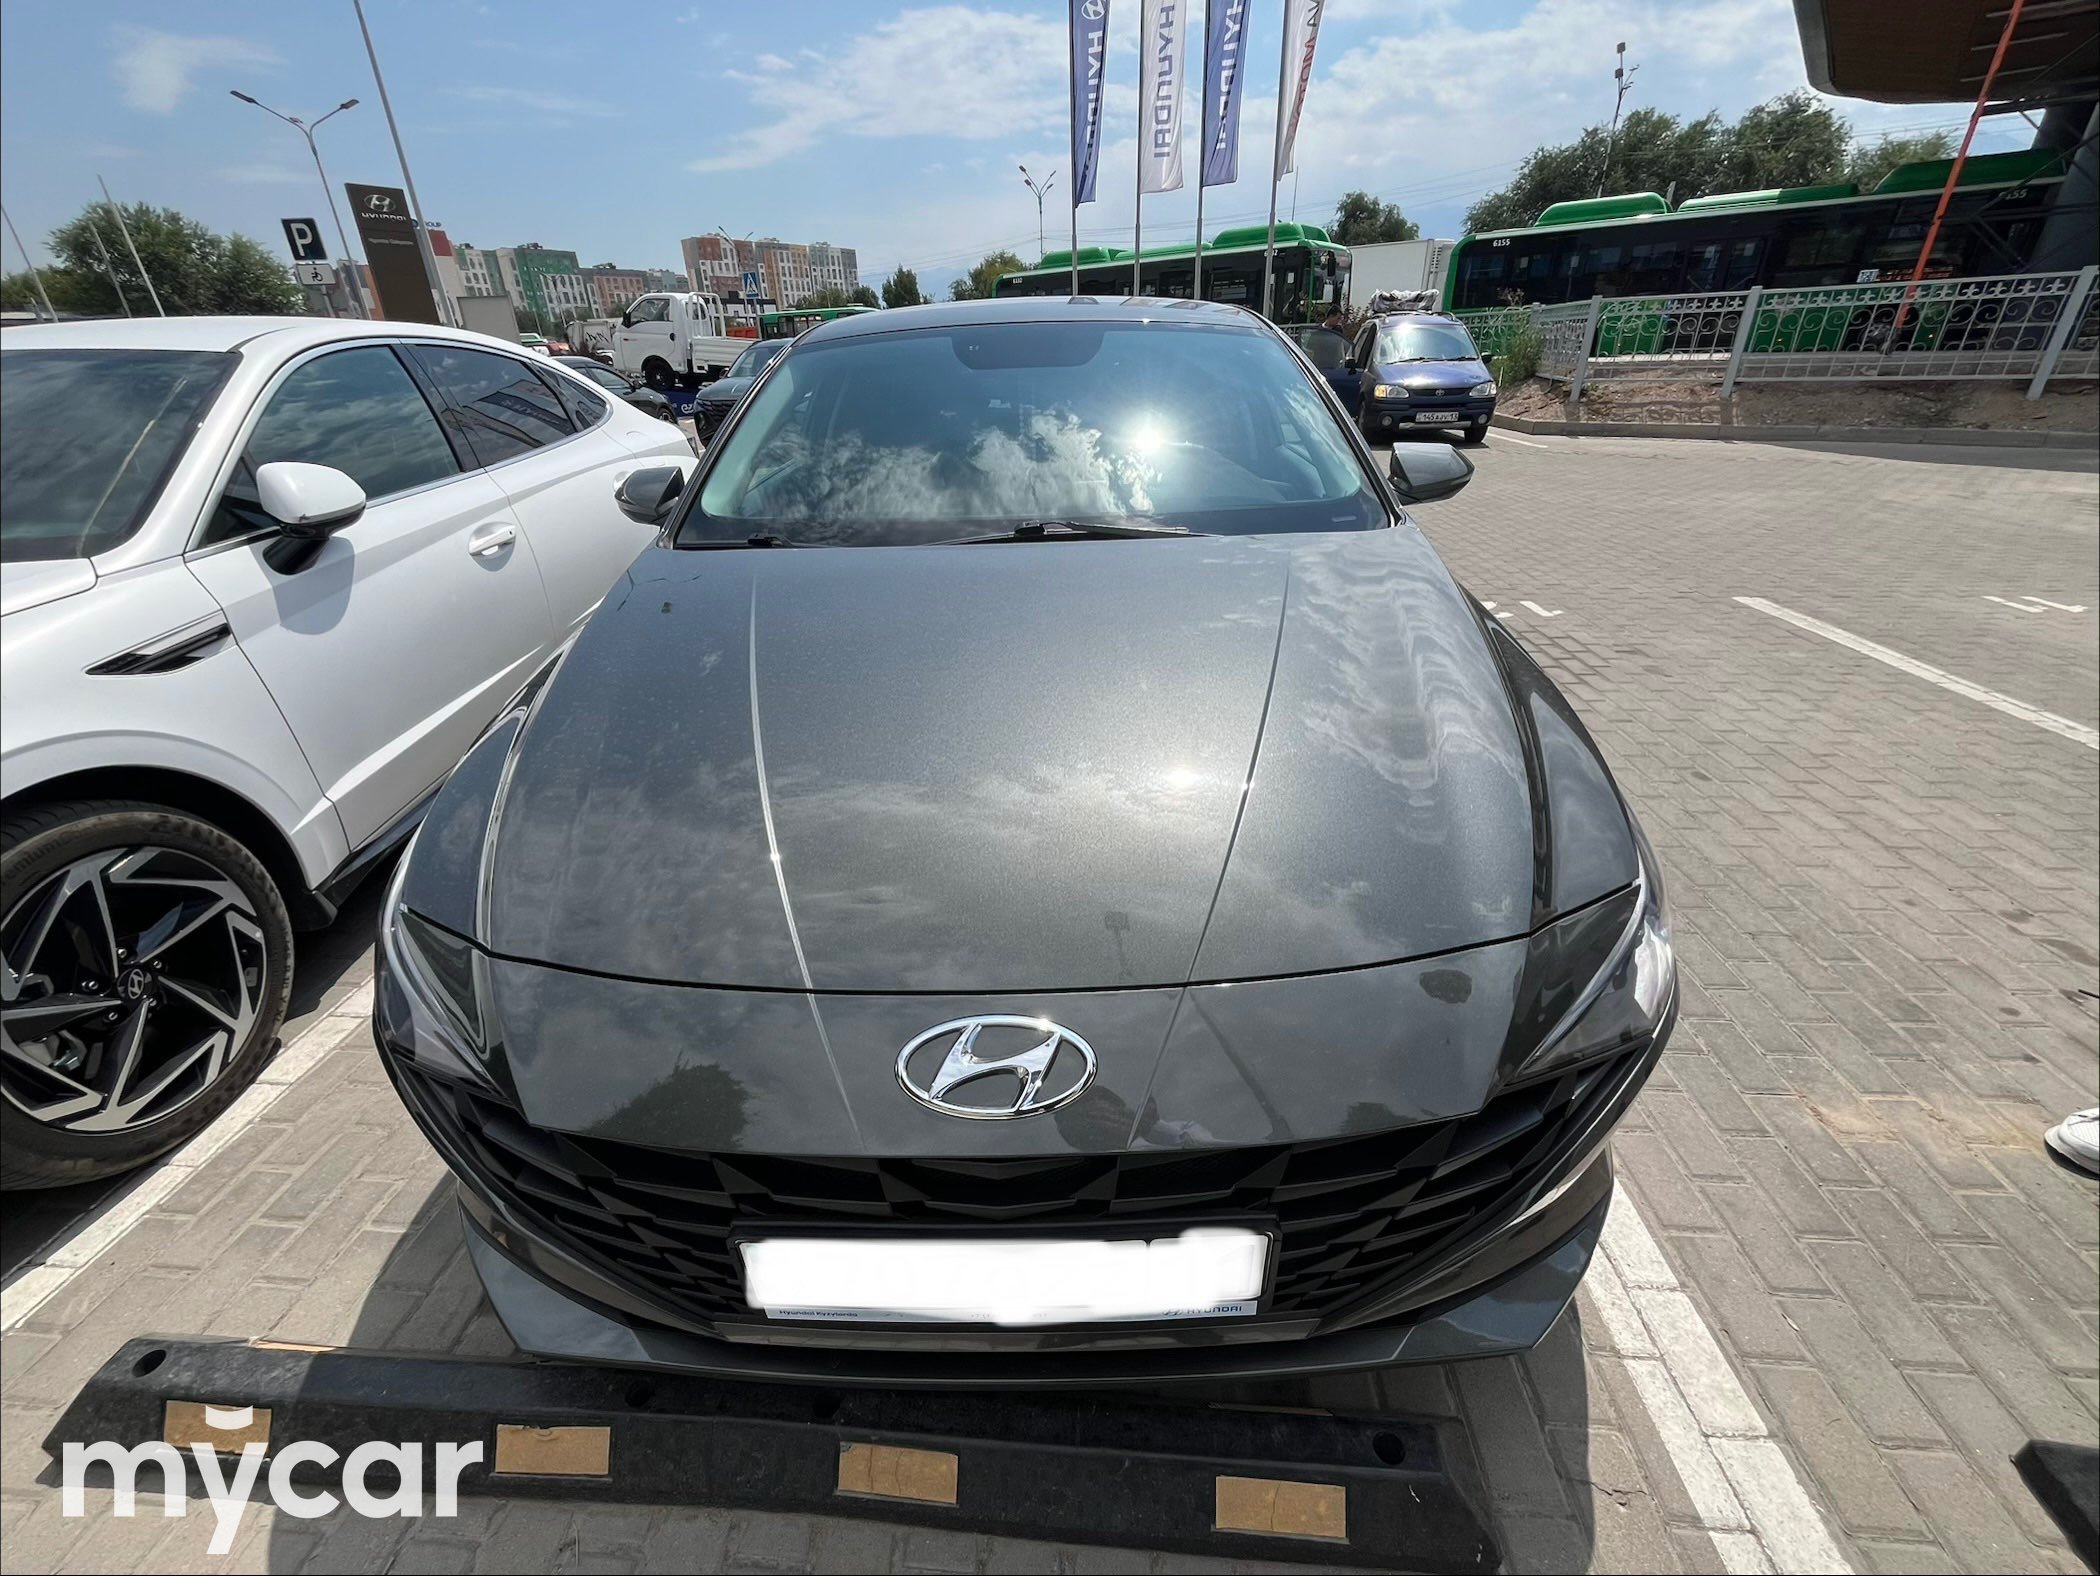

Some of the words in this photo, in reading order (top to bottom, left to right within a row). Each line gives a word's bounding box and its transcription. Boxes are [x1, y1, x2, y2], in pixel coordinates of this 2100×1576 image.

[290, 222, 313, 257] P
[1492, 238, 1511, 248] 6155
[1186, 1305, 1242, 1315] HYUNDAI
